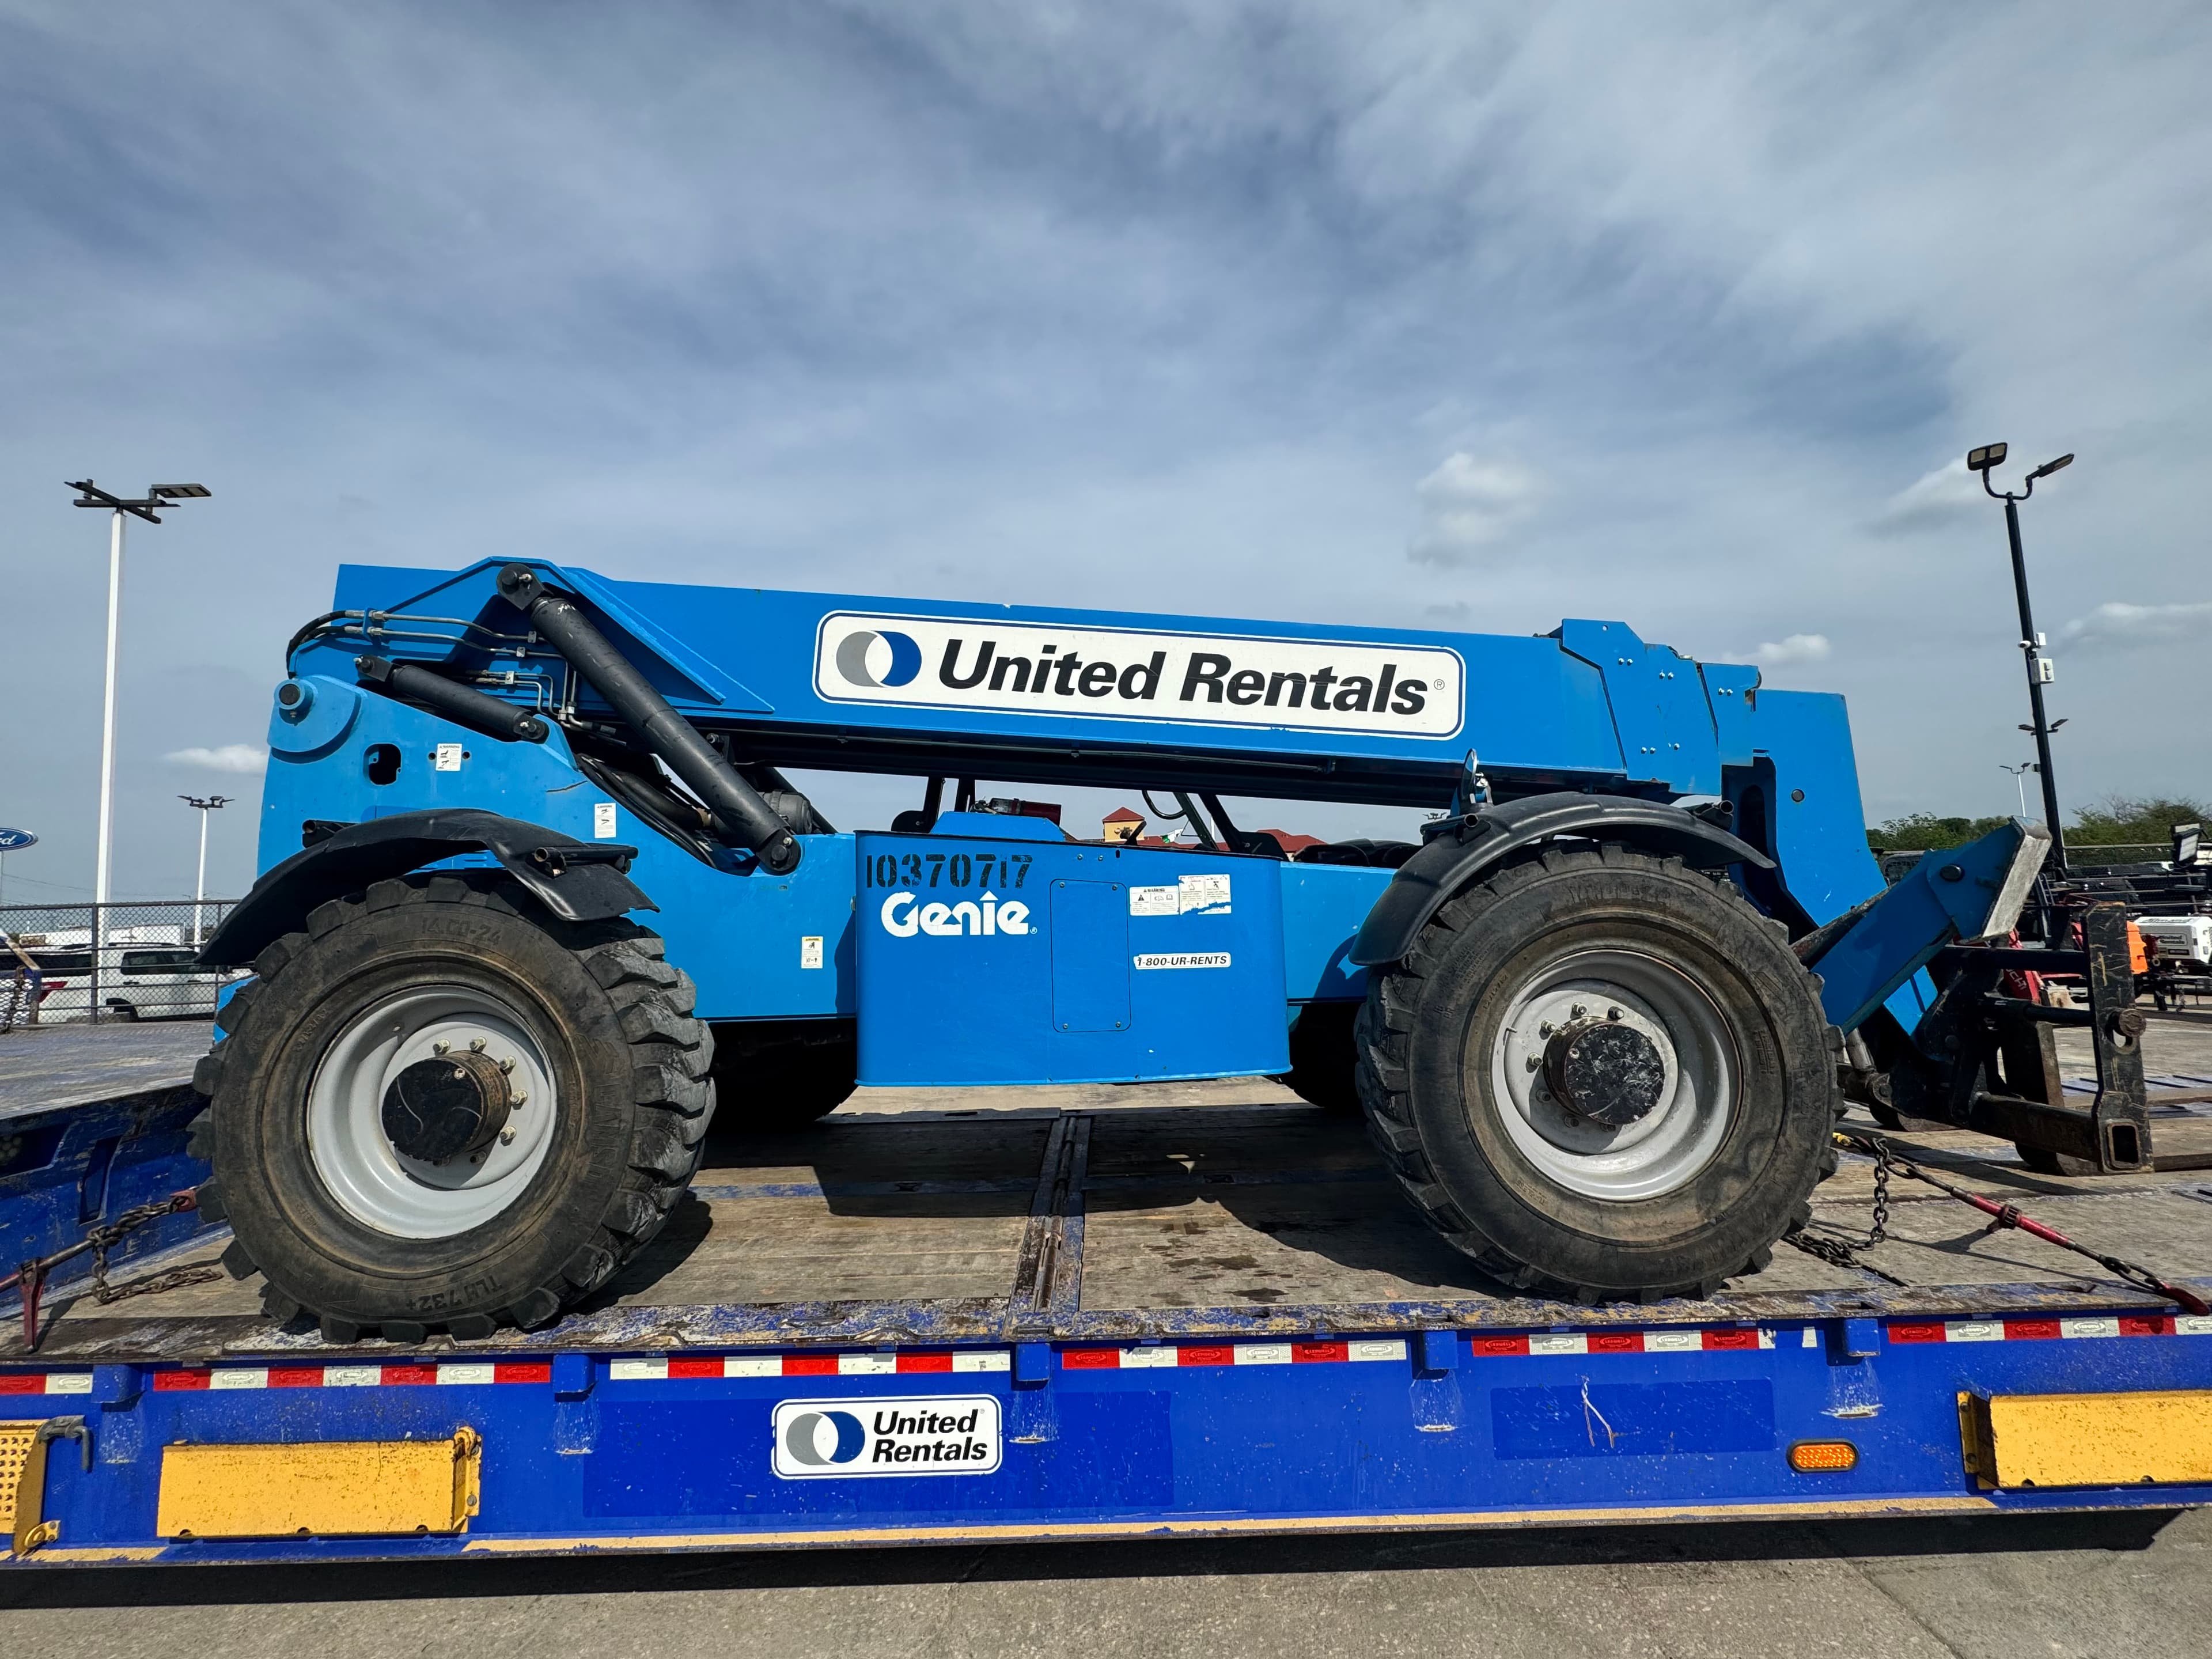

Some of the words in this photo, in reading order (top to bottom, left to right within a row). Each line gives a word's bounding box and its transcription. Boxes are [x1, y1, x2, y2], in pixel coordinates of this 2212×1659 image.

[939, 639, 1167, 700] United
[1179, 652, 1427, 715] Rentals
[866, 854, 1033, 888] 10370717
[881, 890, 1030, 937] Genie
[1137, 956, 1227, 966] 1-800-UR-RENTS
[873, 1408, 979, 1435] United
[872, 1436, 988, 1463] Rentals
